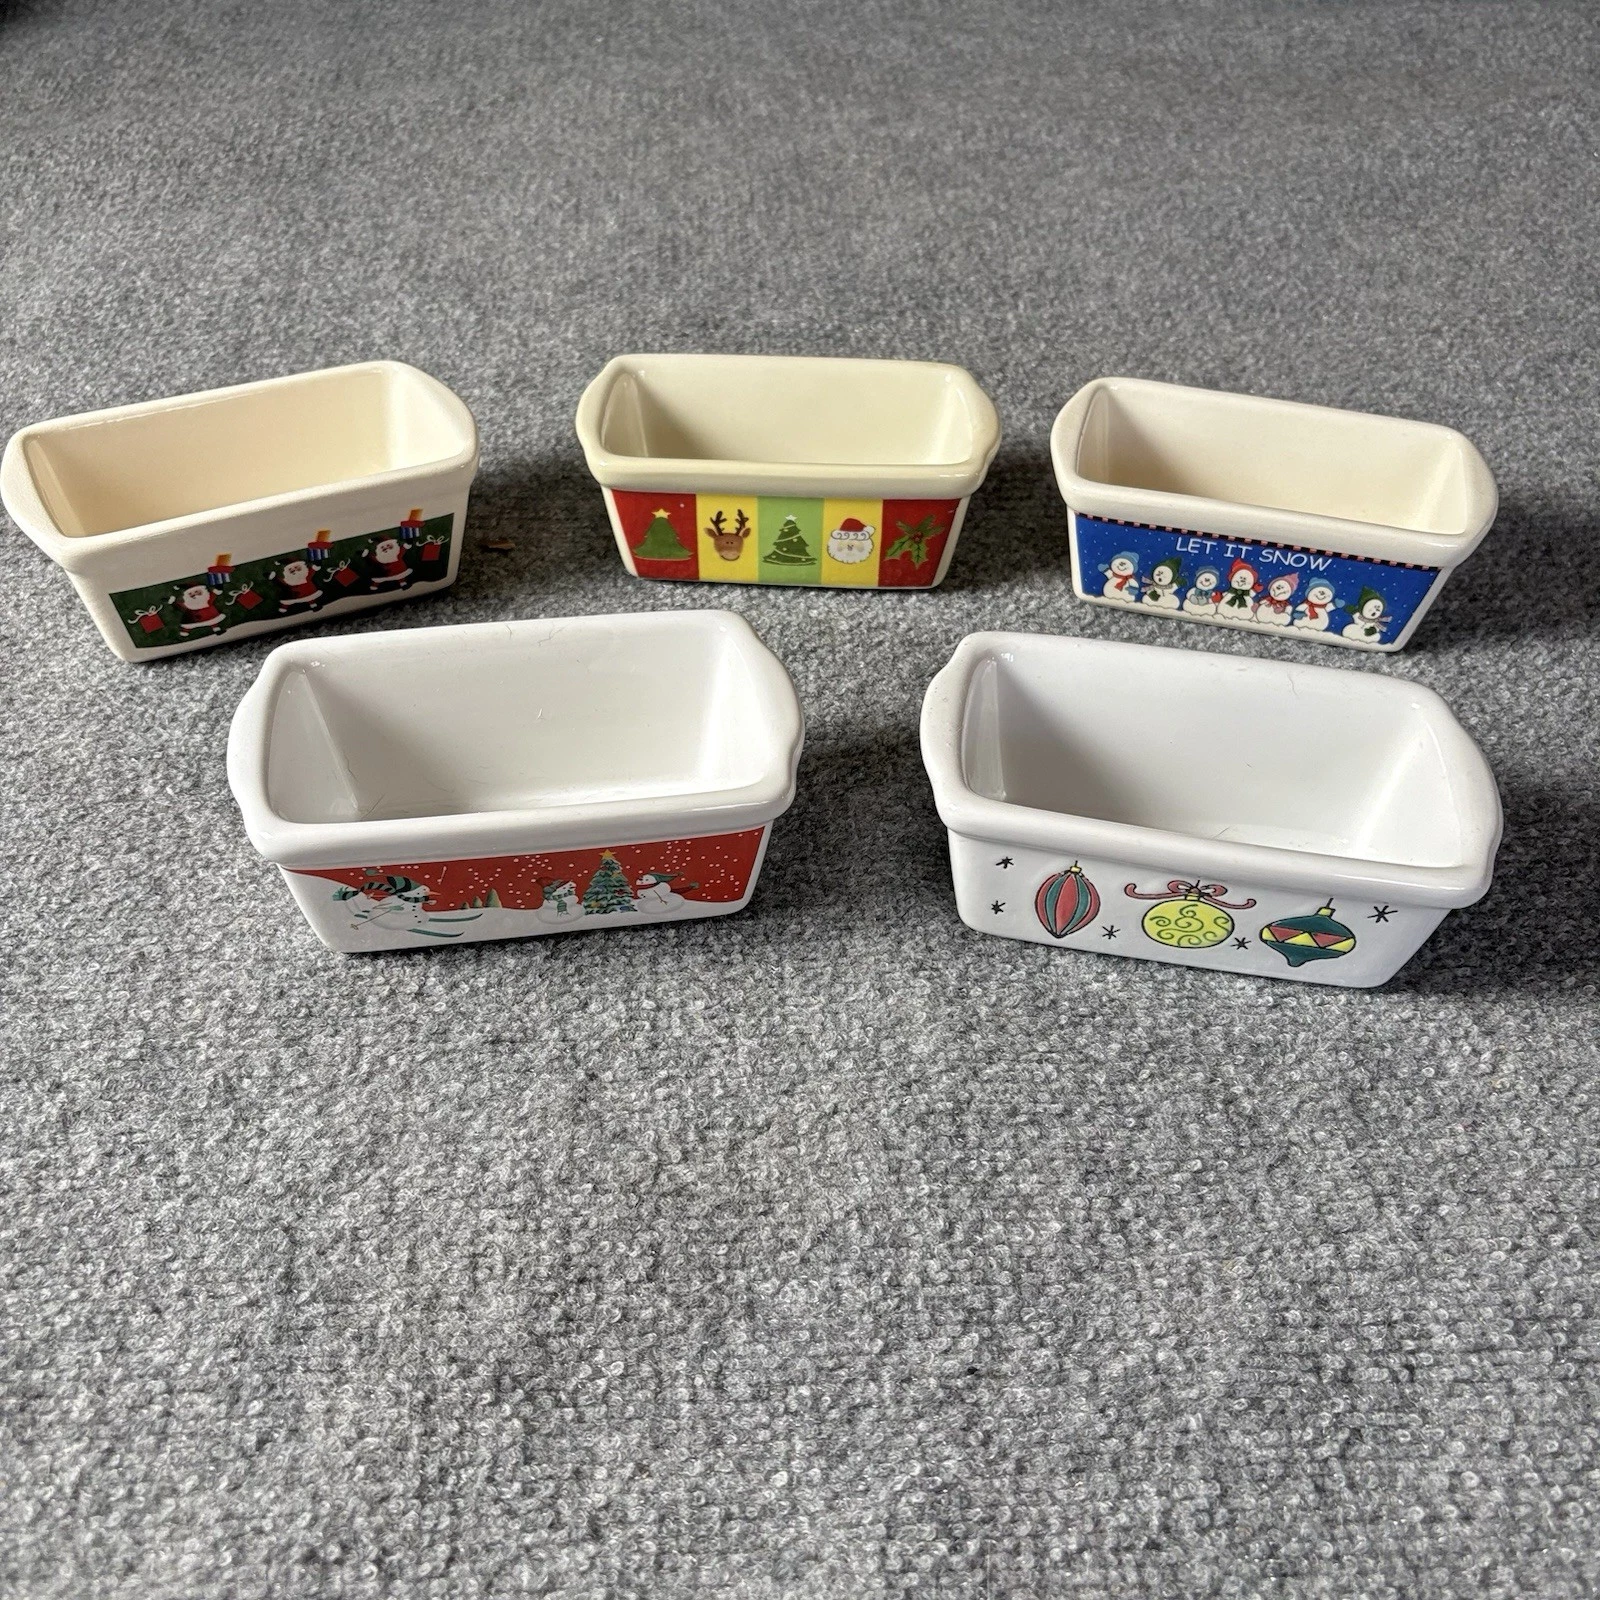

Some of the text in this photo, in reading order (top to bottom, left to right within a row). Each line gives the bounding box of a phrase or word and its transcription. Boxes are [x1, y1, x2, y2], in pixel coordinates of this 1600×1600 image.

[1176, 536, 1332, 571] LET IT SNOW
